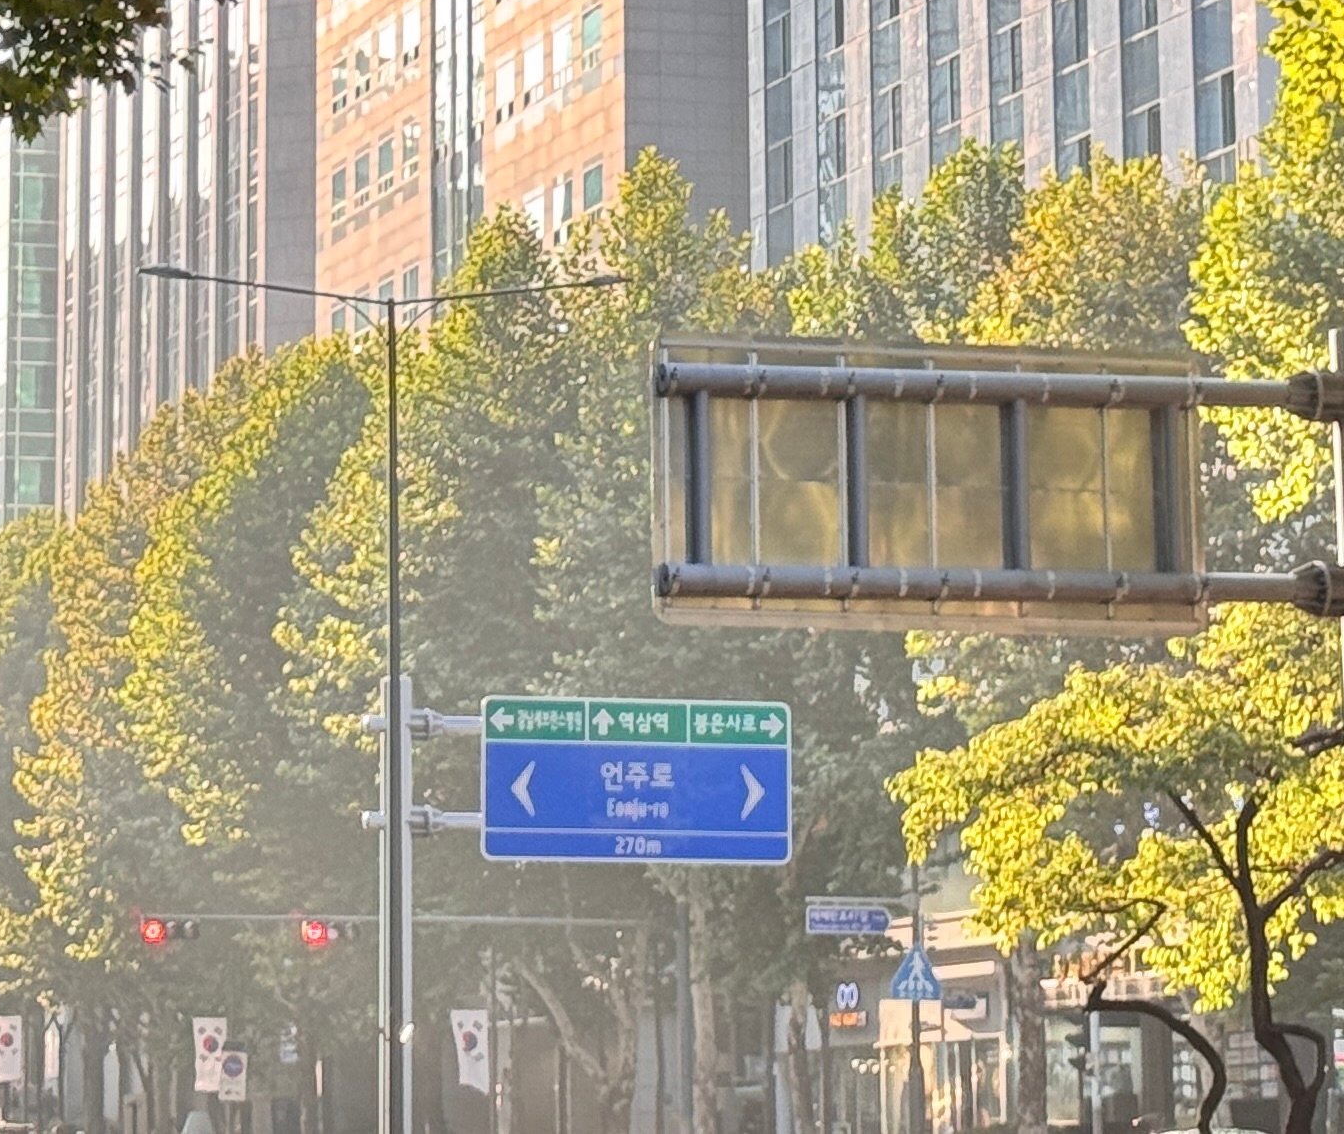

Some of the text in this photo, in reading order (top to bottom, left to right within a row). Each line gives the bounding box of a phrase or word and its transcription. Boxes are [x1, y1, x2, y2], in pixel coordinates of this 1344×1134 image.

[618, 711, 669, 734] 역삼역
[693, 712, 757, 735] 봉은사로
[599, 761, 675, 791] 언주로
[614, 835, 662, 855] 270m
